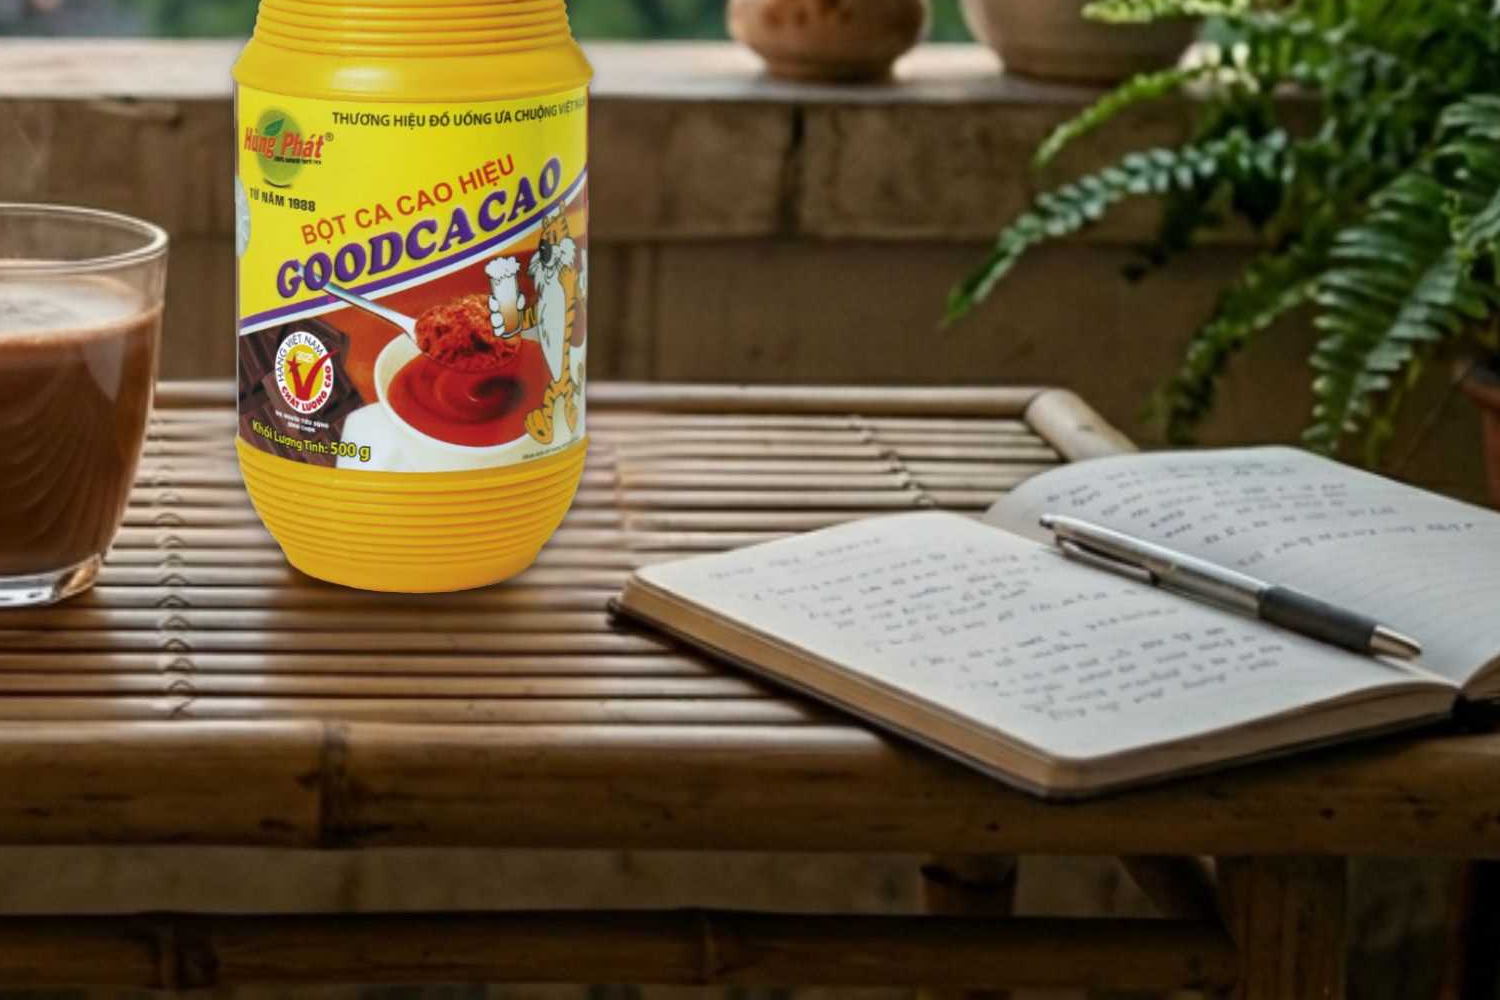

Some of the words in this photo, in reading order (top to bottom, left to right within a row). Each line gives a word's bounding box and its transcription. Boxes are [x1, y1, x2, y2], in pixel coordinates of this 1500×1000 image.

[332, 111, 390, 127] THƯƠNG
[393, 112, 426, 130] HIỆU
[453, 110, 492, 126] UỐNG
[515, 104, 557, 122] CHUỘNG
[243, 127, 277, 160] Hùng
[281, 131, 325, 159] Phát
[287, 197, 316, 213] 1988
[301, 214, 347, 245] BỘT
[355, 203, 393, 229] CA
[396, 182, 453, 216] CAO
[459, 153, 515, 195] HIỆU
[276, 156, 562, 299] GOODCACAO
[324, 365, 332, 388] CAO
[330, 440, 357, 457] 500
[359, 446, 371, 462] g
